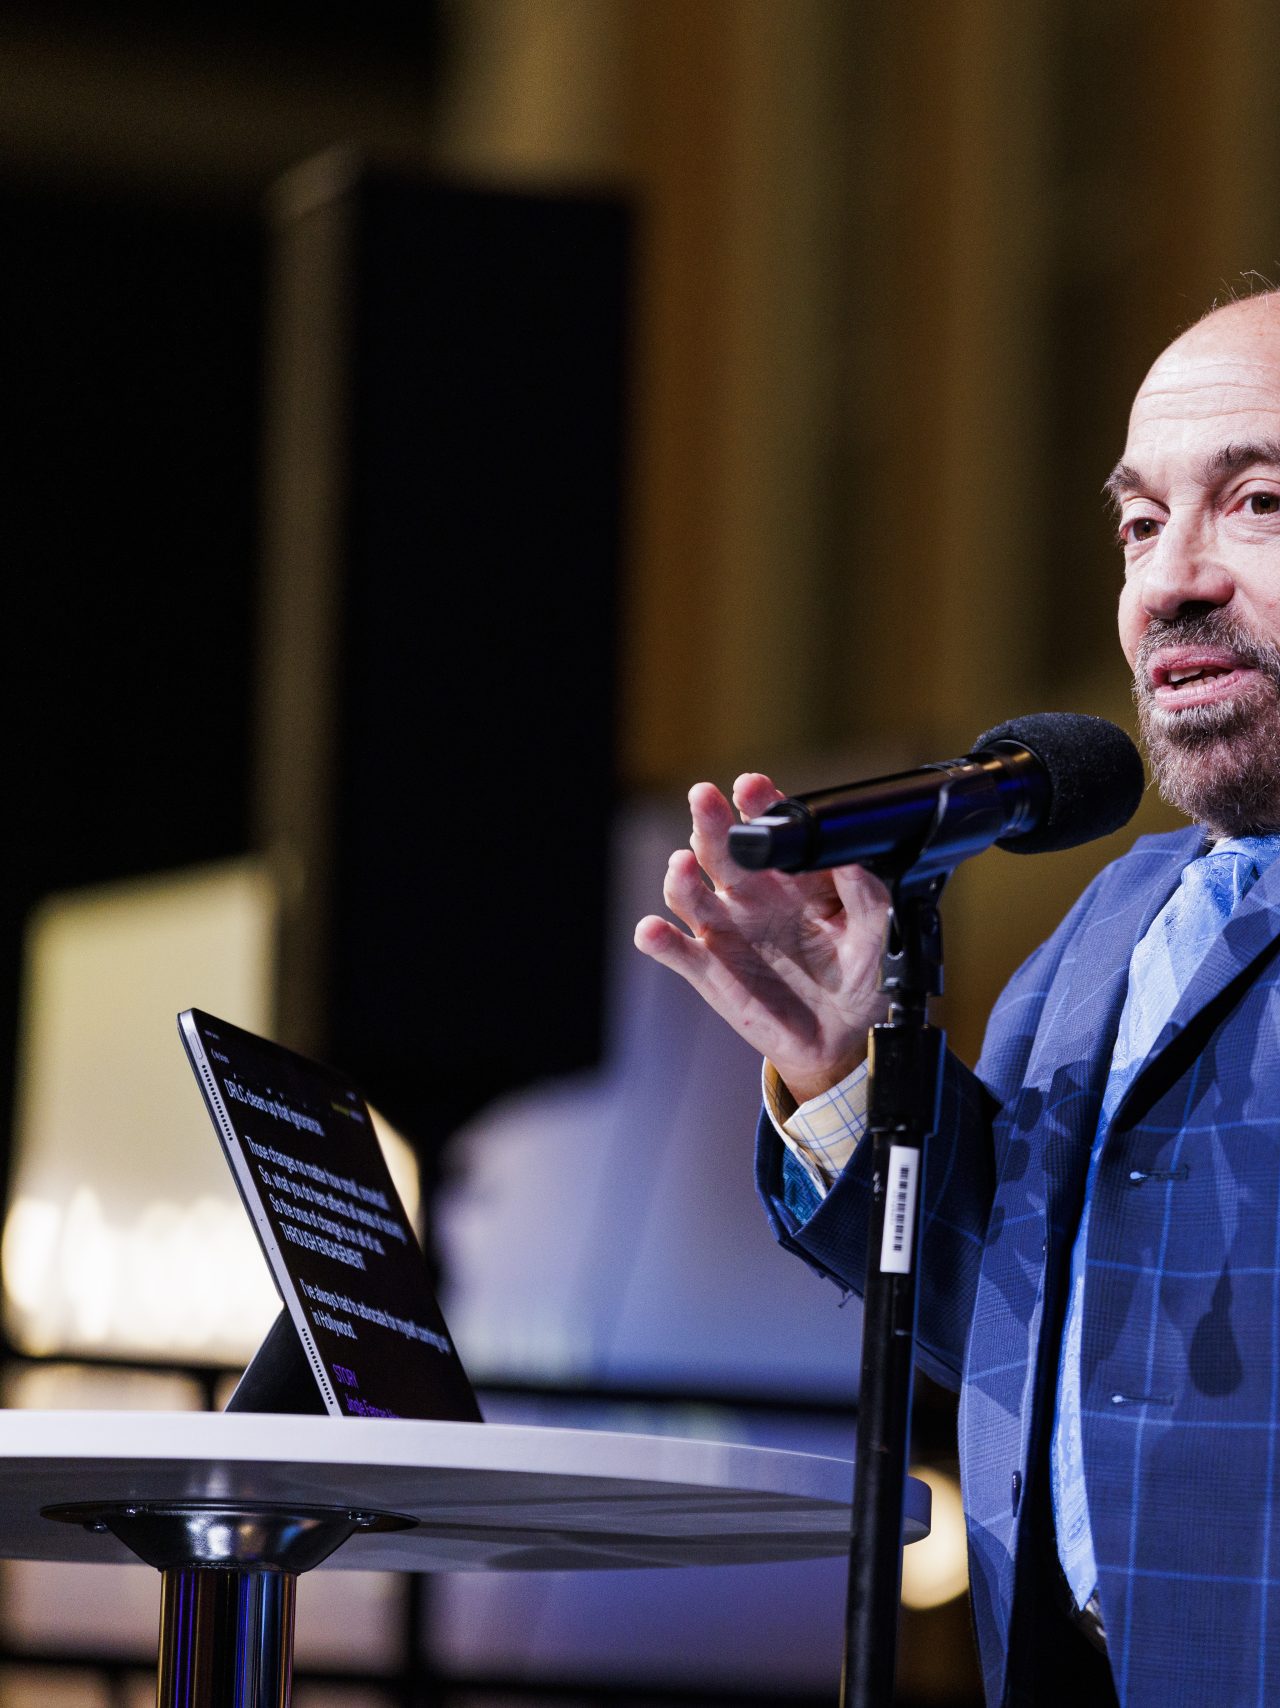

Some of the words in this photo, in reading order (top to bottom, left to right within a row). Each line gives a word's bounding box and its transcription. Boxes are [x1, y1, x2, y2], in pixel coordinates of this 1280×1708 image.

[279, 1221, 319, 1252] THROUGH
[315, 1235, 365, 1270] ENGAGEMENT
[332, 1363, 358, 1387] STORY
